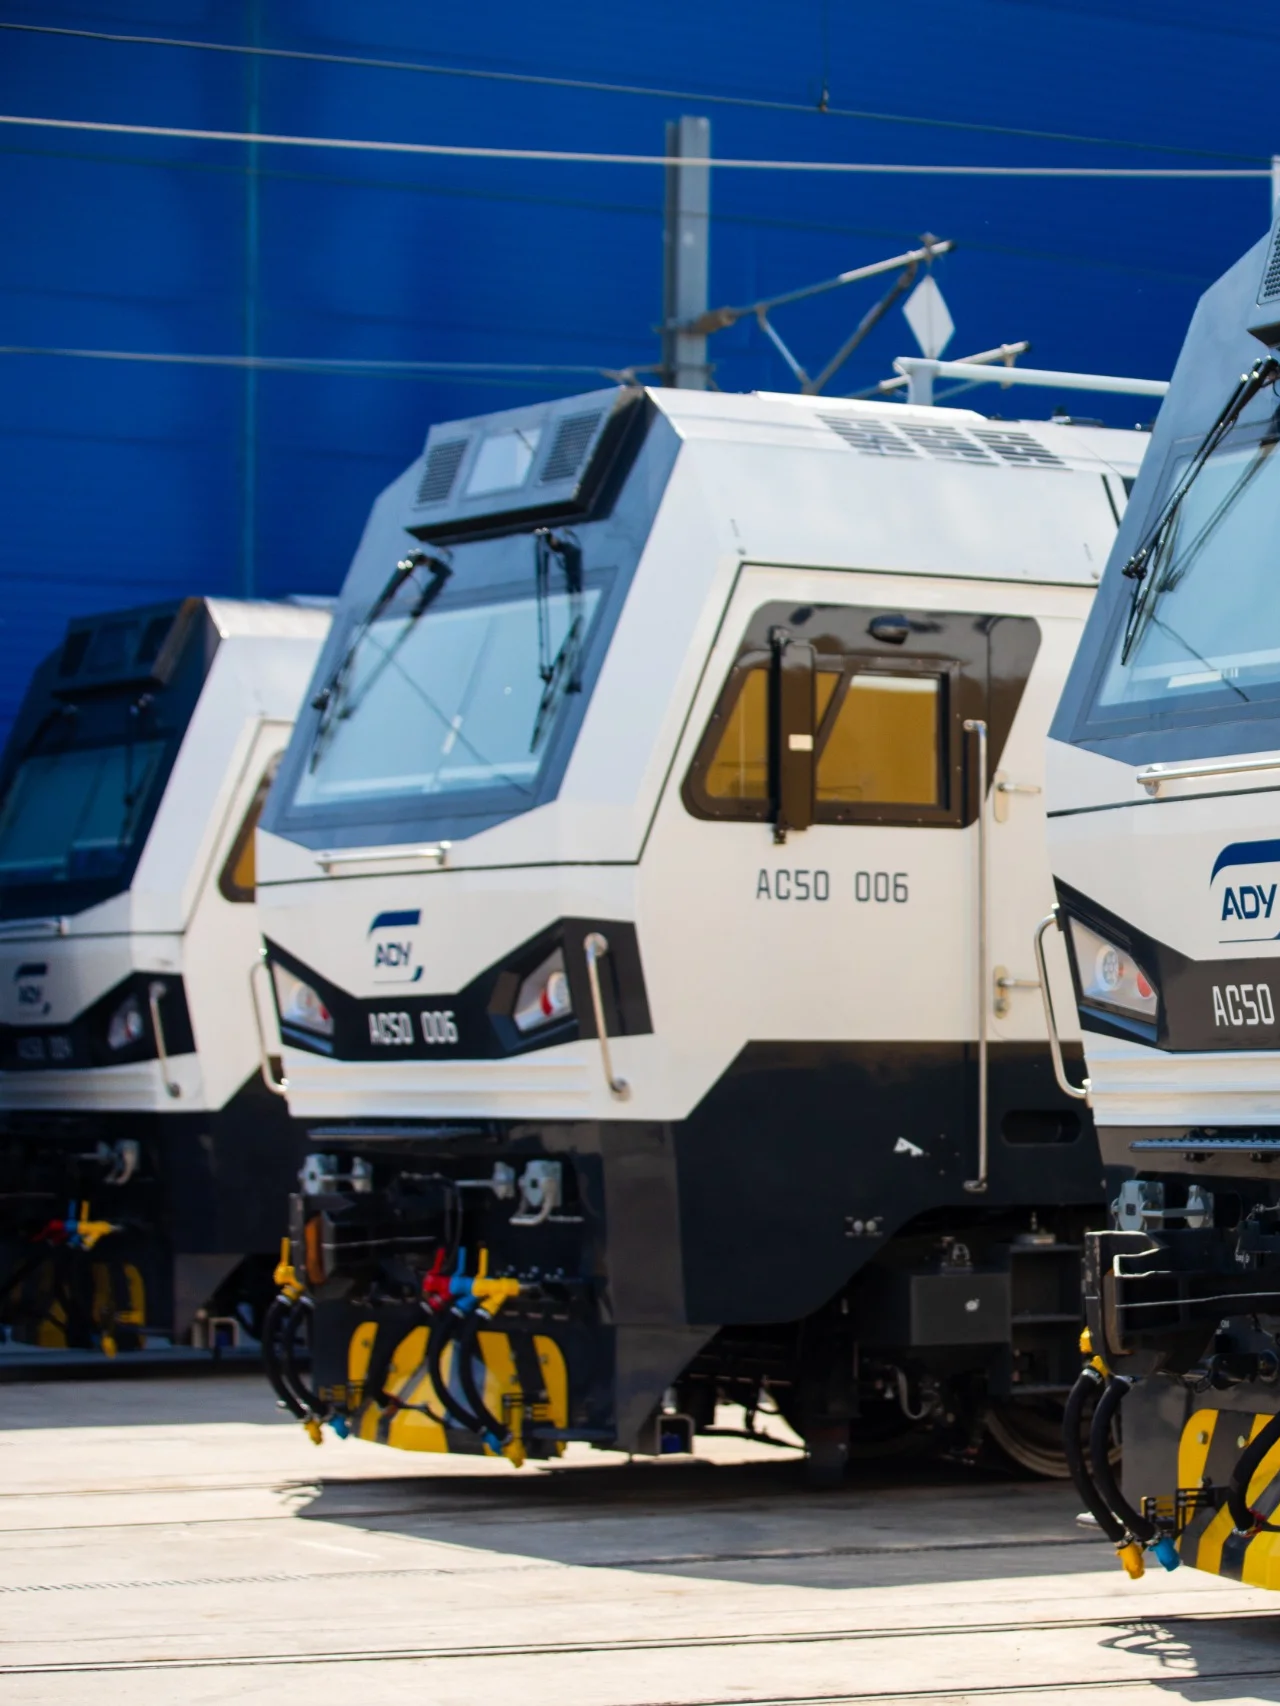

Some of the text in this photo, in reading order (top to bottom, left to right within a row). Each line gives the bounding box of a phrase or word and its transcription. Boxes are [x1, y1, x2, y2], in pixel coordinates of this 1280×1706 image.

[756, 868, 909, 903] AC50 006
[1221, 883, 1278, 921] ADY
[374, 941, 412, 968] ADY
[1212, 983, 1275, 1026] AC50
[368, 1012, 414, 1045] AC50
